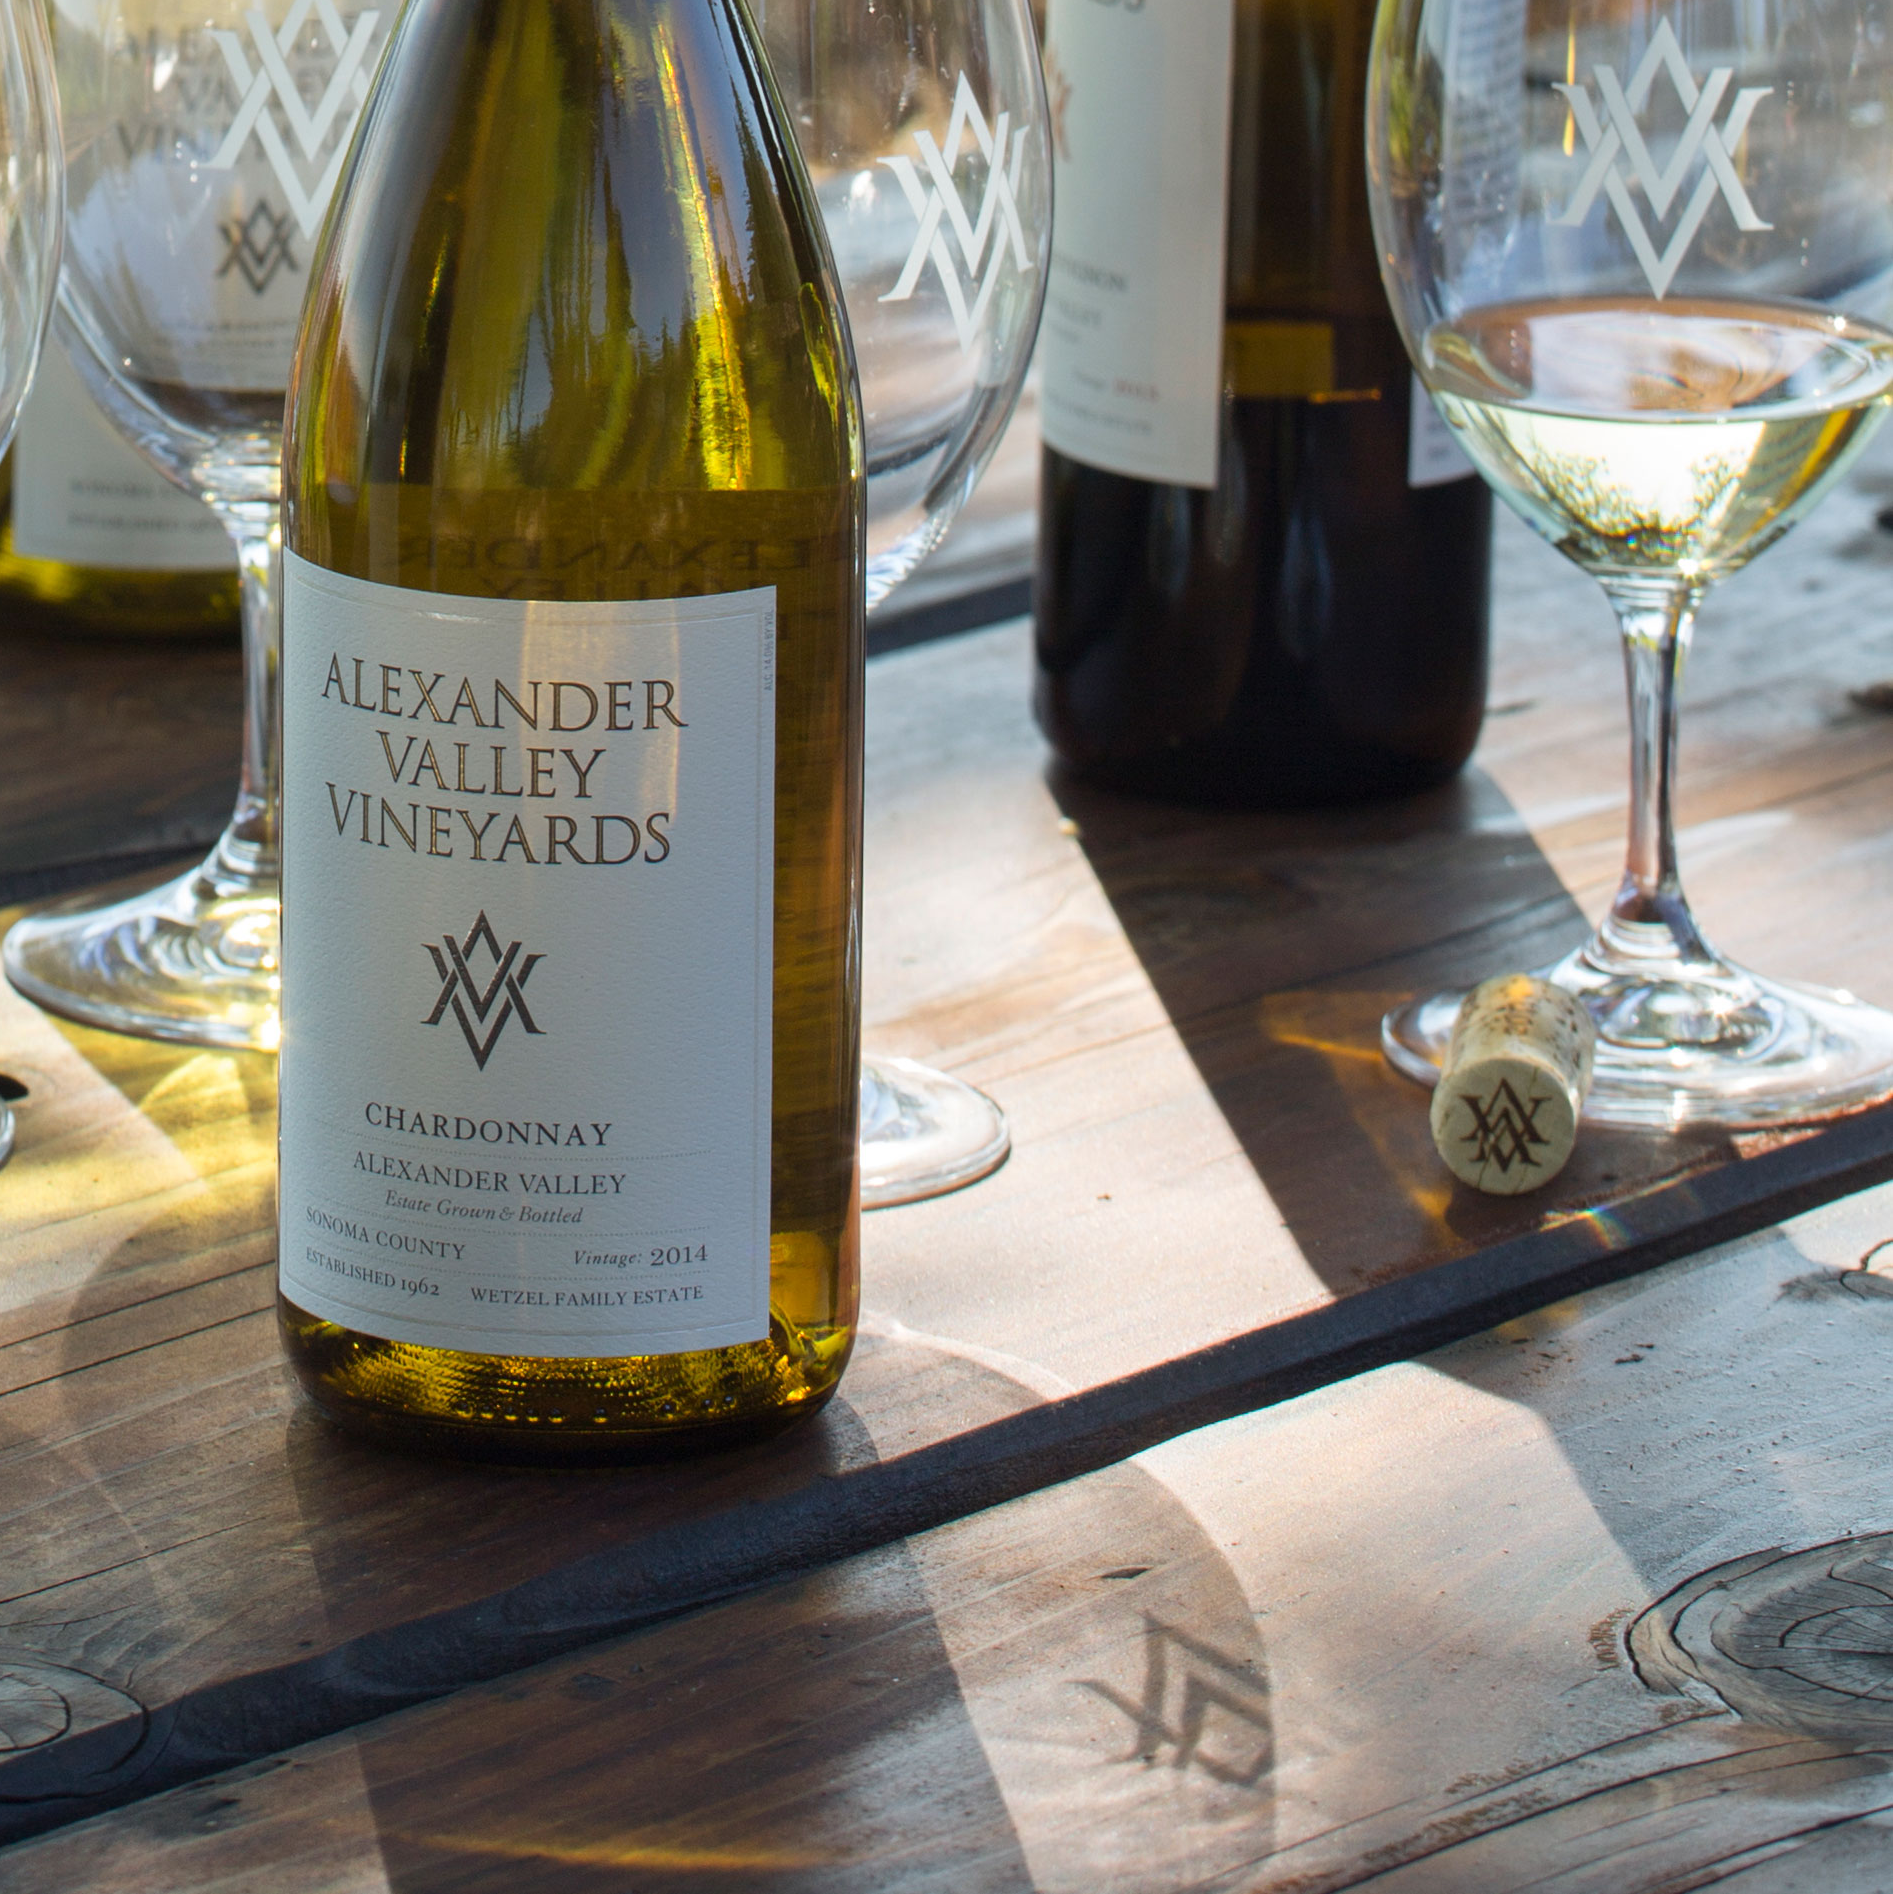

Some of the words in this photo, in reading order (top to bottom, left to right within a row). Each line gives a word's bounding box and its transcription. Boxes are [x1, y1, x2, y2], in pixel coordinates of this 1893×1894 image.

[321, 651, 689, 731] ALEXANDER
[375, 730, 606, 799] VALLEY
[325, 781, 671, 865] VINEYARDS
[364, 1101, 613, 1148] CHARDONNAY
[353, 1150, 509, 1193] ALEXANDER
[518, 1173, 627, 1195] VALLEY
[385, 1188, 432, 1214] Estate
[436, 1197, 496, 1221] Grown
[498, 1203, 515, 1221] &
[518, 1204, 584, 1224] Bottled
[305, 1205, 370, 1244] SONOMA
[375, 1230, 466, 1261] COUNTY
[573, 1249, 643, 1268] Vintage:
[649, 1244, 708, 1267] 2014
[305, 1247, 396, 1289] ESTABLISHED
[400, 1277, 440, 1299] 1962
[470, 1286, 550, 1307] WETZEL
[554, 1290, 628, 1307] FAMILY
[632, 1284, 704, 1305] ESTATE
